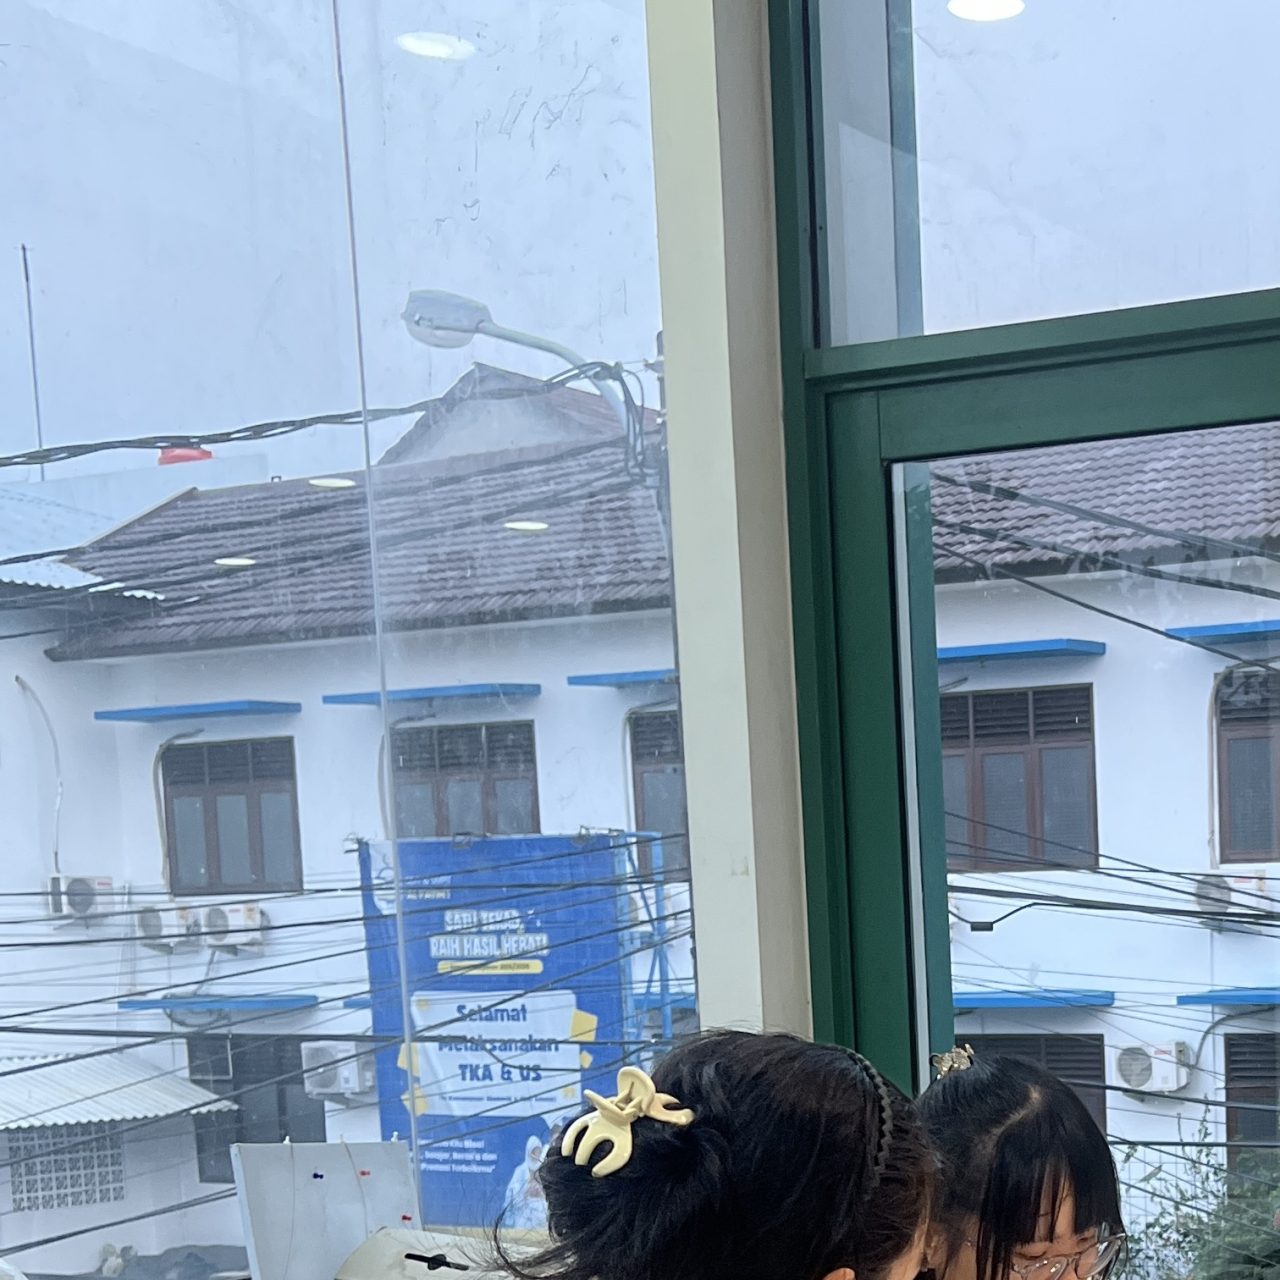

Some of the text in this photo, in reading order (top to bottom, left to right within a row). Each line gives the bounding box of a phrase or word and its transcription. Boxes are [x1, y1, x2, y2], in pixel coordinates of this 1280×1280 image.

[445, 910, 477, 932] SATU
[430, 935, 460, 957] RAIH
[463, 934, 499, 957] HASIL
[456, 1004, 527, 1022] Selamat
[458, 1064, 542, 1081] TKA & US
